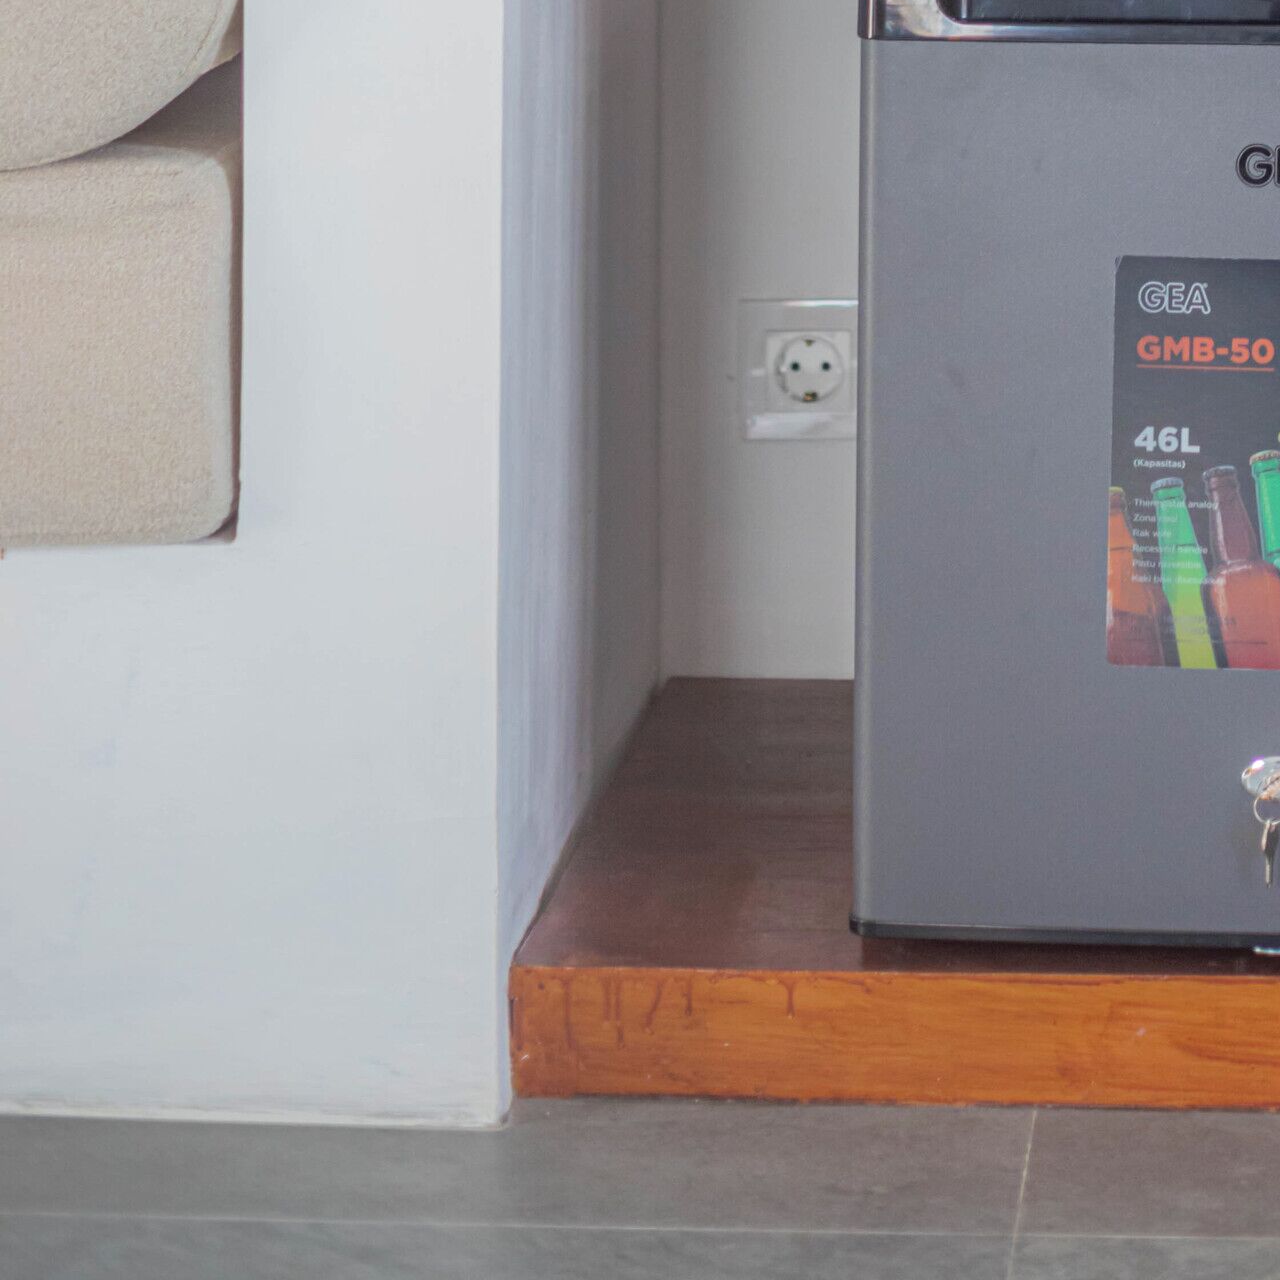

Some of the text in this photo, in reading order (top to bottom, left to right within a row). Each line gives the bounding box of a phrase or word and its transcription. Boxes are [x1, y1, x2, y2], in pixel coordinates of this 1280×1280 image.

[1136, 335, 1275, 365] GMB-50
[1134, 426, 1200, 453] 46L
[1133, 459, 1186, 469] (Kapasitas)
[1188, 501, 1218, 511] analog
[1133, 513, 1156, 522] Zona
[1132, 529, 1150, 538] Rak
